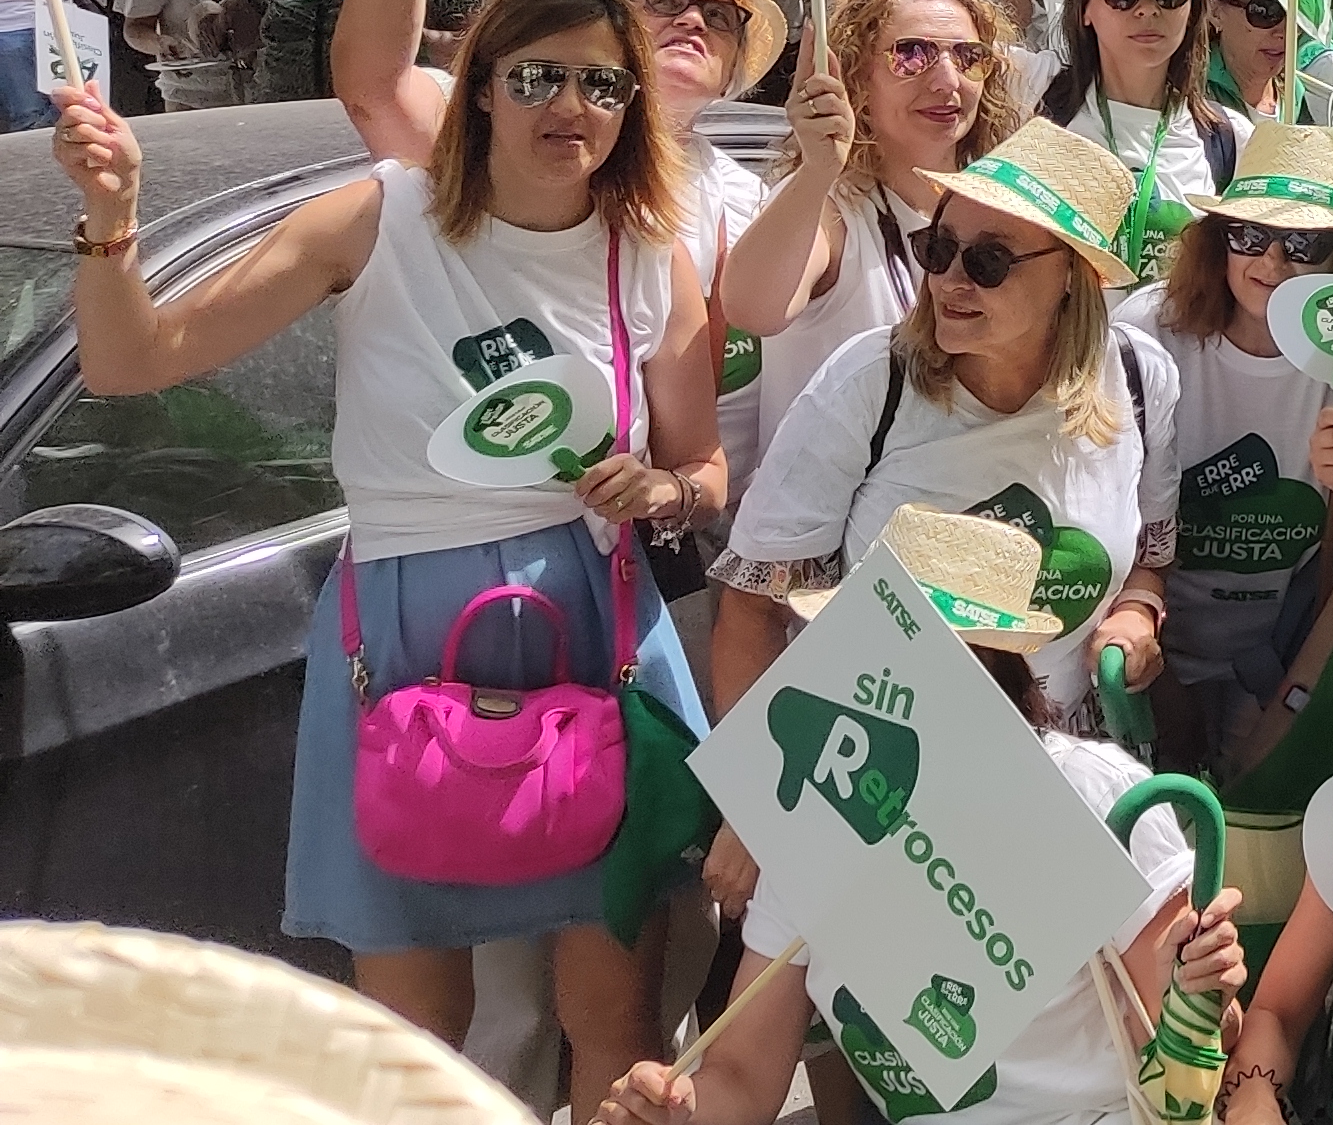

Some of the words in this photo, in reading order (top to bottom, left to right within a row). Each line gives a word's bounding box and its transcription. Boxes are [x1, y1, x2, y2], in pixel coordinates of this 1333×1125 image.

[1196, 454, 1240, 487] ERRE
[1221, 461, 1264, 496] ERRE
[1181, 523, 1319, 541] CLASIFICACIÓN
[1231, 514, 1255, 524] POR
[1258, 514, 1283, 524] UNA
[1193, 540, 1283, 560] JUSTA
[874, 577, 922, 642] SATSE
[1211, 588, 1280, 602] SATSE
[853, 666, 915, 720] sin
[813, 714, 1034, 992] Retrocesos
[918, 1009, 949, 1048] JUSTA
